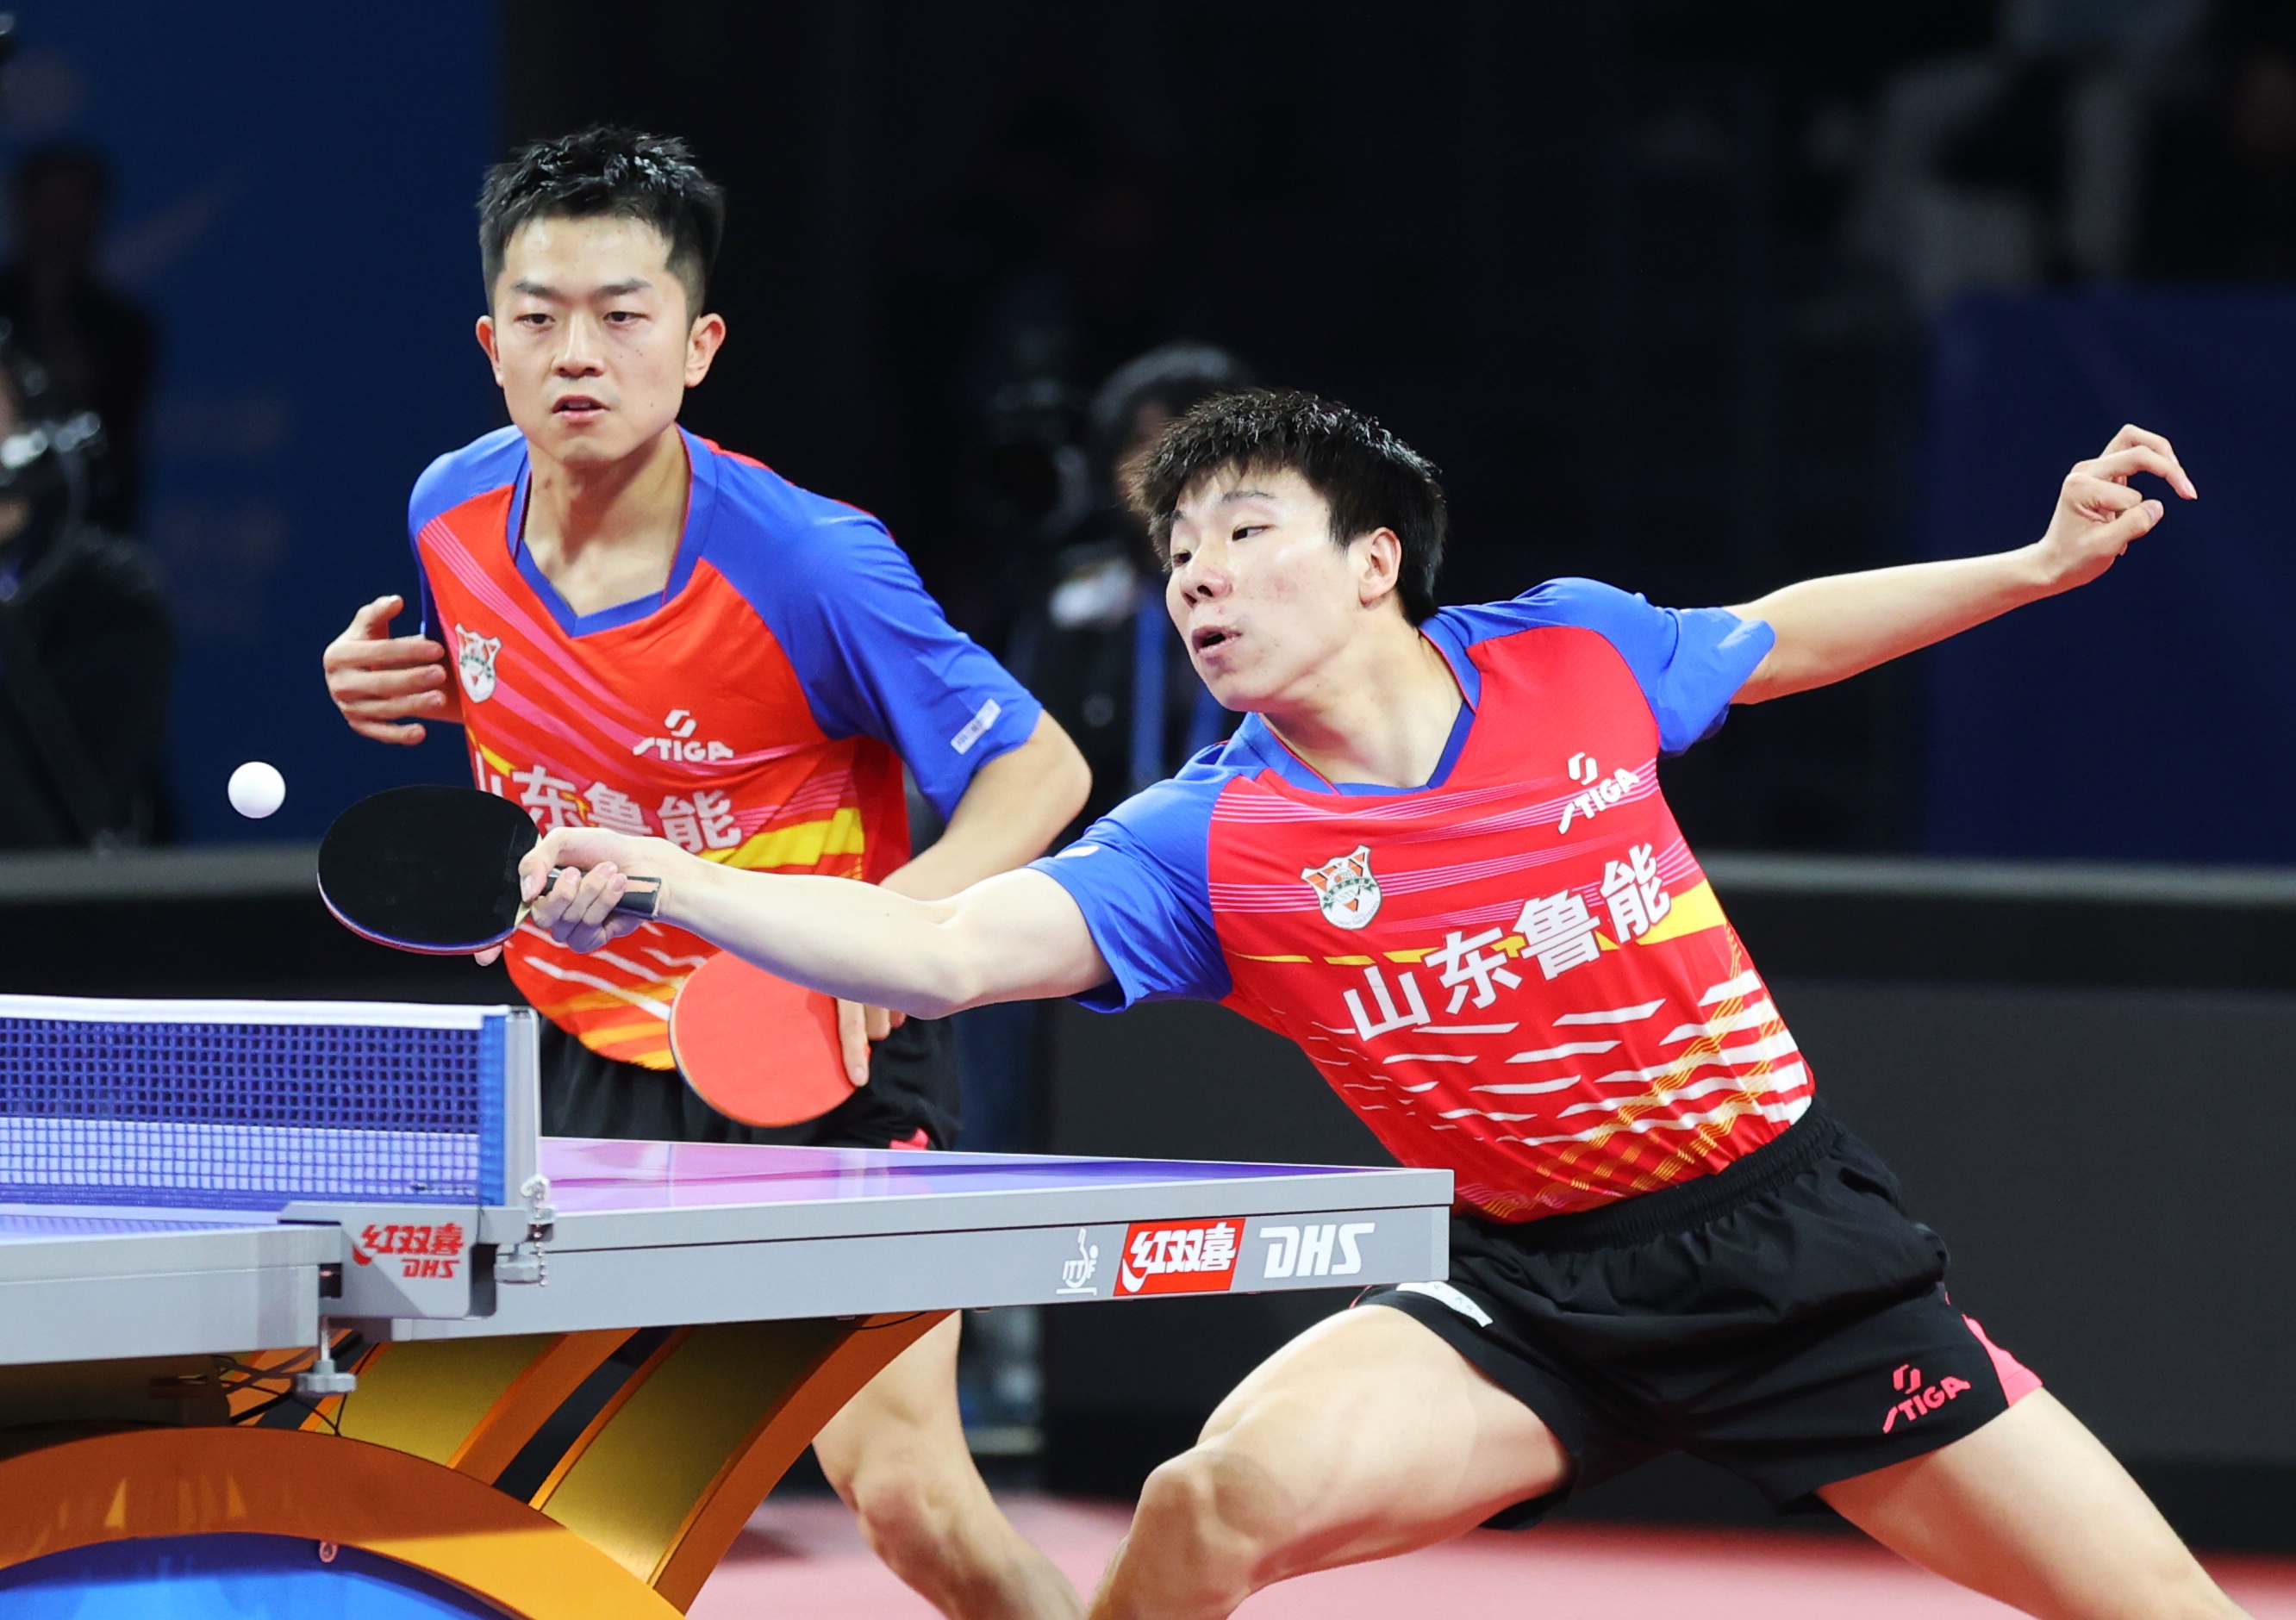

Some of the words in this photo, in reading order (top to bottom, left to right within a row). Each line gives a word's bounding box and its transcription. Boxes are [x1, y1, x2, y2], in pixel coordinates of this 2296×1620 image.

[633, 736, 734, 763] STIGA
[1557, 767, 1640, 835] STIGA
[1342, 841, 1672, 1042] 山东鲁能
[353, 1222, 465, 1266] 红双喜
[401, 1258, 460, 1279] DHS
[1122, 1221, 1237, 1293] 红双喜
[1259, 1222, 1376, 1280] DHS
[1882, 1376, 1972, 1434] STIGA
